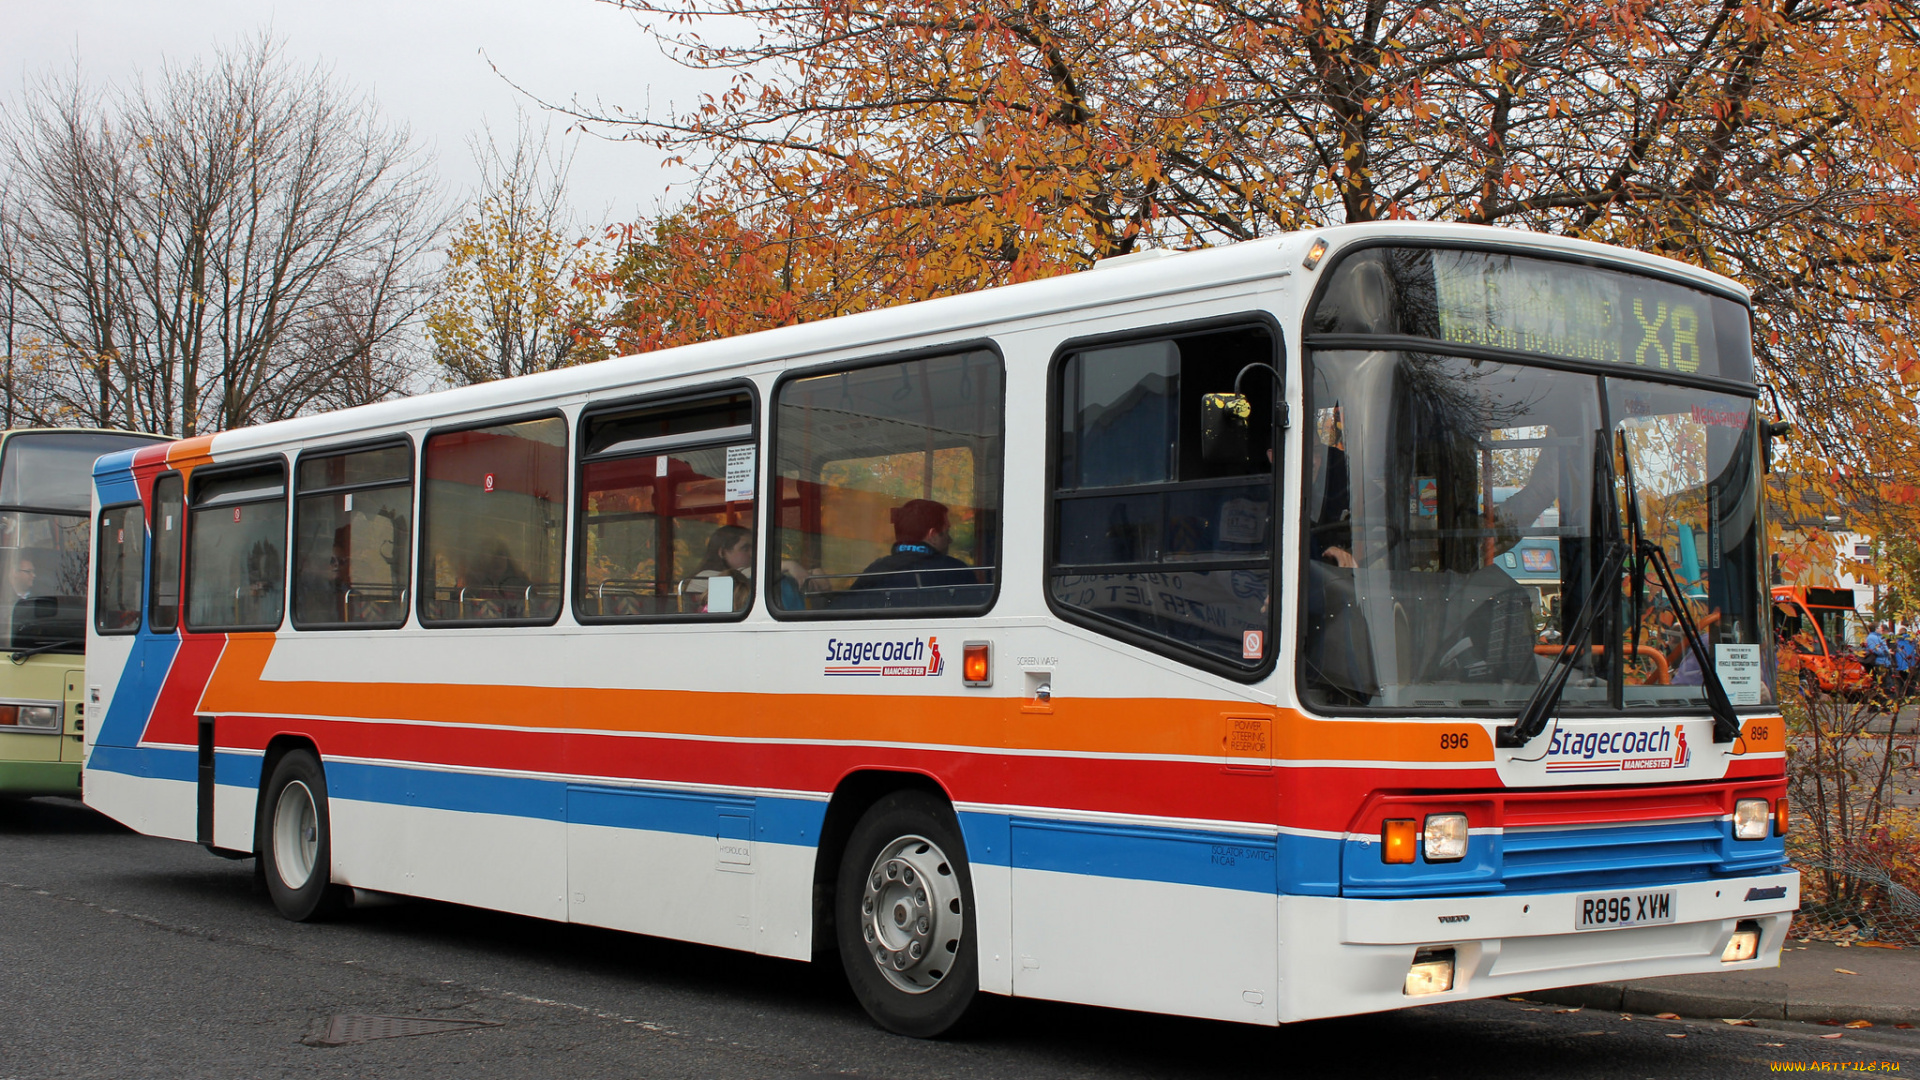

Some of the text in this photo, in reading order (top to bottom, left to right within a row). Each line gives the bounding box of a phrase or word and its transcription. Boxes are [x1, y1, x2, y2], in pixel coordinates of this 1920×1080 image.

[1632, 297, 1700, 374] X8
[825, 637, 924, 665] Stagecoach
[1016, 656, 1059, 666] SCREEN WASH
[883, 667, 925, 676] MANCHESTER
[1234, 721, 1262, 730] POWER
[1231, 731, 1265, 742] STEERING
[1750, 726, 1769, 741] 896
[1230, 741, 1266, 752] RESERVOIR
[1440, 732, 1469, 749] 896
[1547, 726, 1671, 759] Stagecoach
[1623, 759, 1671, 769] MANCHESTER
[1211, 845, 1275, 862] ISOLATOR SWITCH
[1211, 855, 1236, 866] IN CAB
[1583, 893, 1670, 925] R896 XVM
